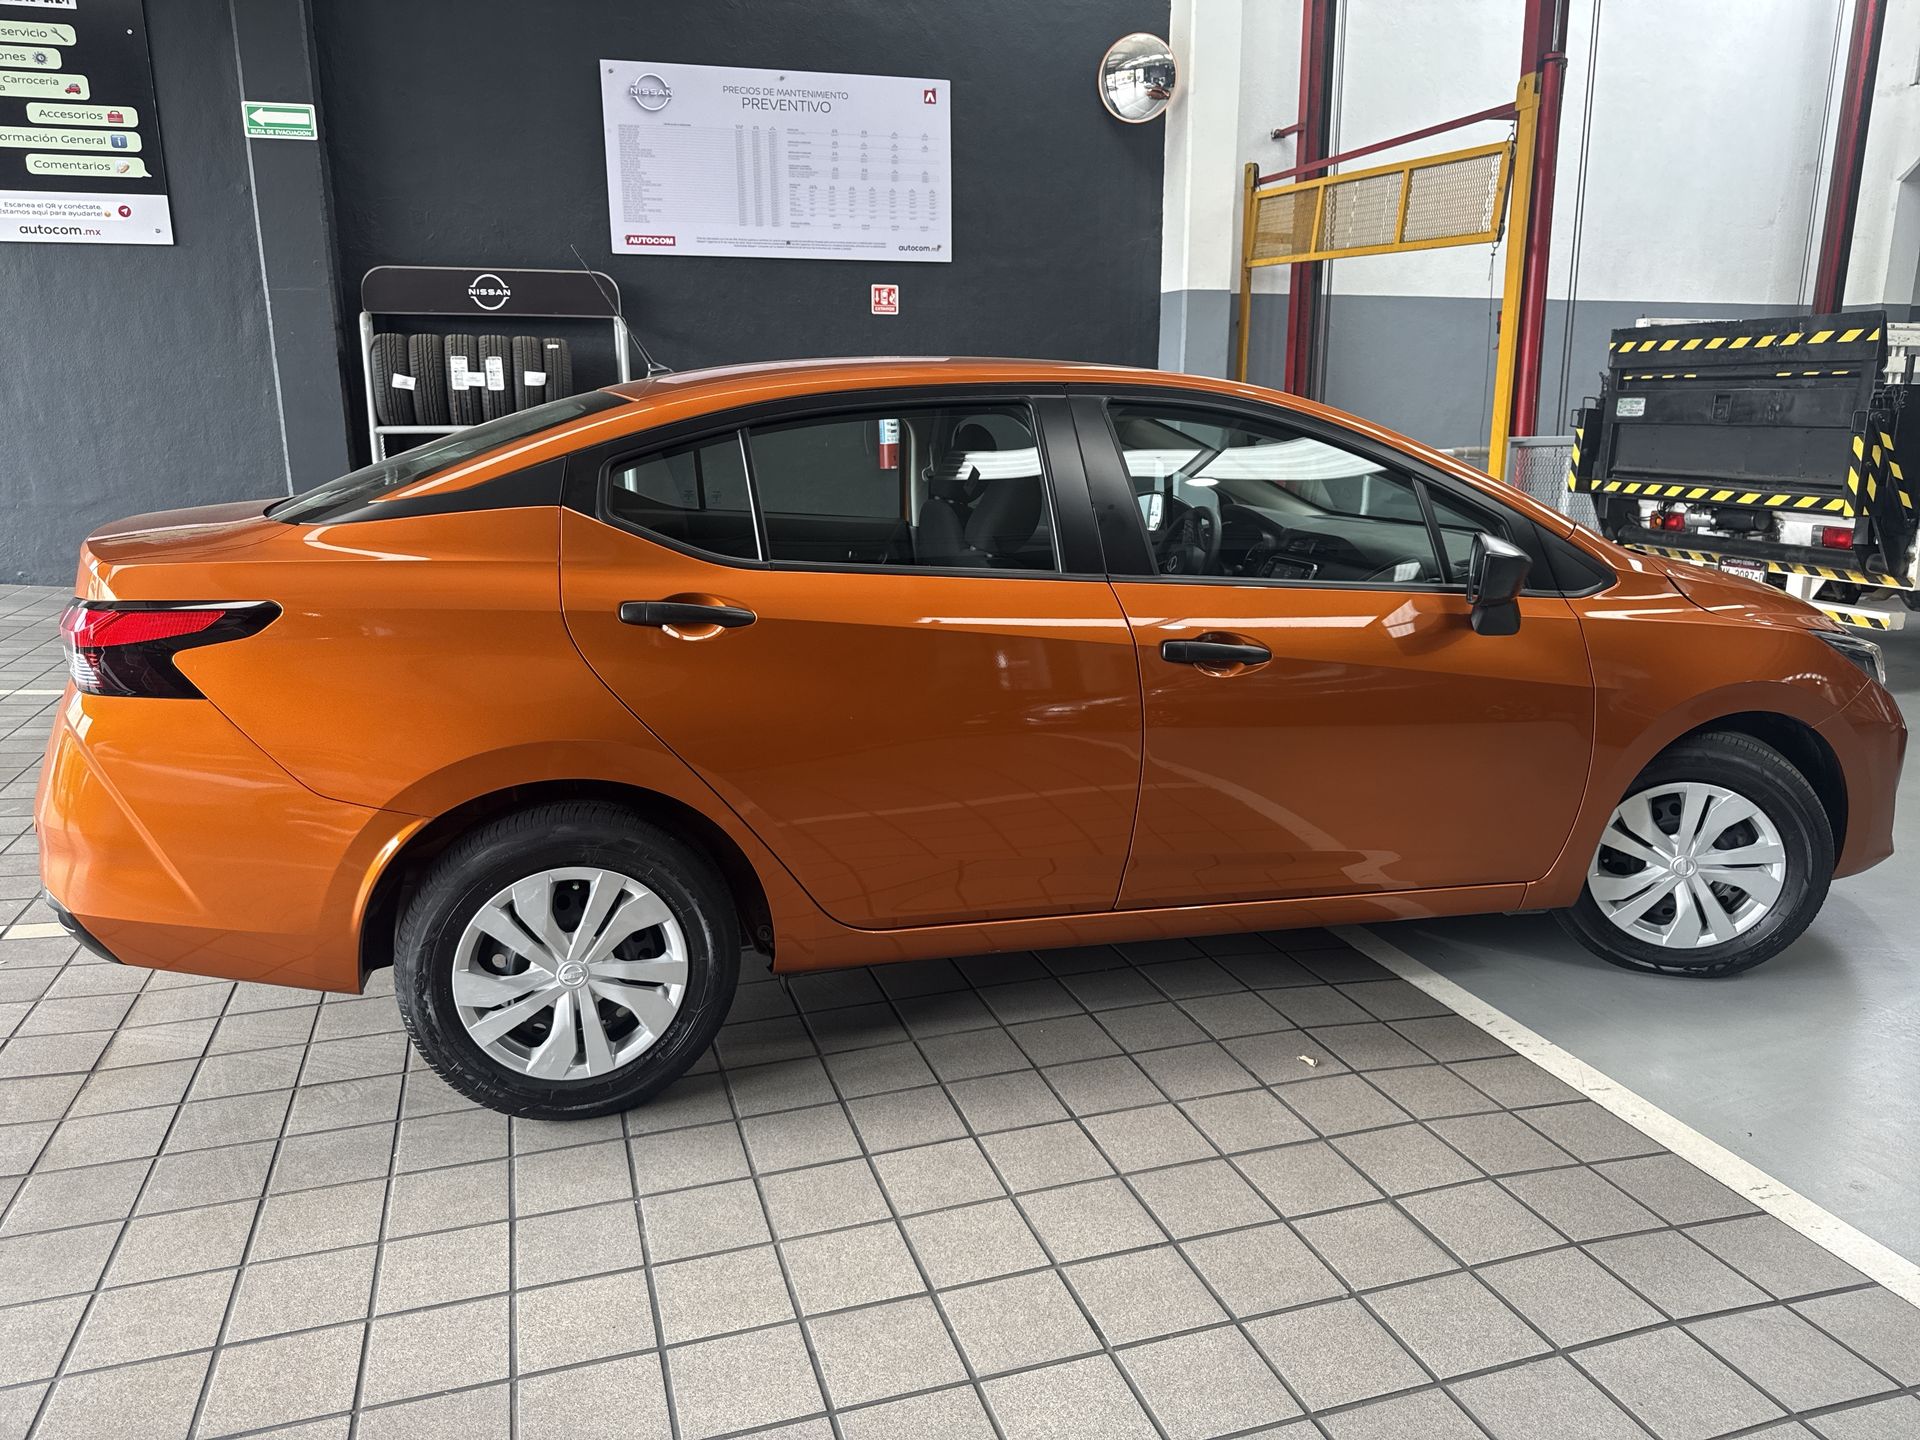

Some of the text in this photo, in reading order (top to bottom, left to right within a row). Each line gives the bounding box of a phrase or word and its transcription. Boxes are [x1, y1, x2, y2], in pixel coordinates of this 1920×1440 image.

[1, 28, 48, 38] servicio
[630, 87, 673, 96] NISSAN
[722, 85, 849, 100] PRECIOS DE MANTENIMIENTO
[741, 96, 832, 113] PREVENTIVO
[38, 108, 104, 120] Accesorios
[60, 134, 107, 145] General
[33, 159, 111, 171] Comentarios
[19, 224, 102, 236] autocom.mx
[629, 236, 674, 245] AUTOCOM
[467, 288, 511, 296] NISSAN
